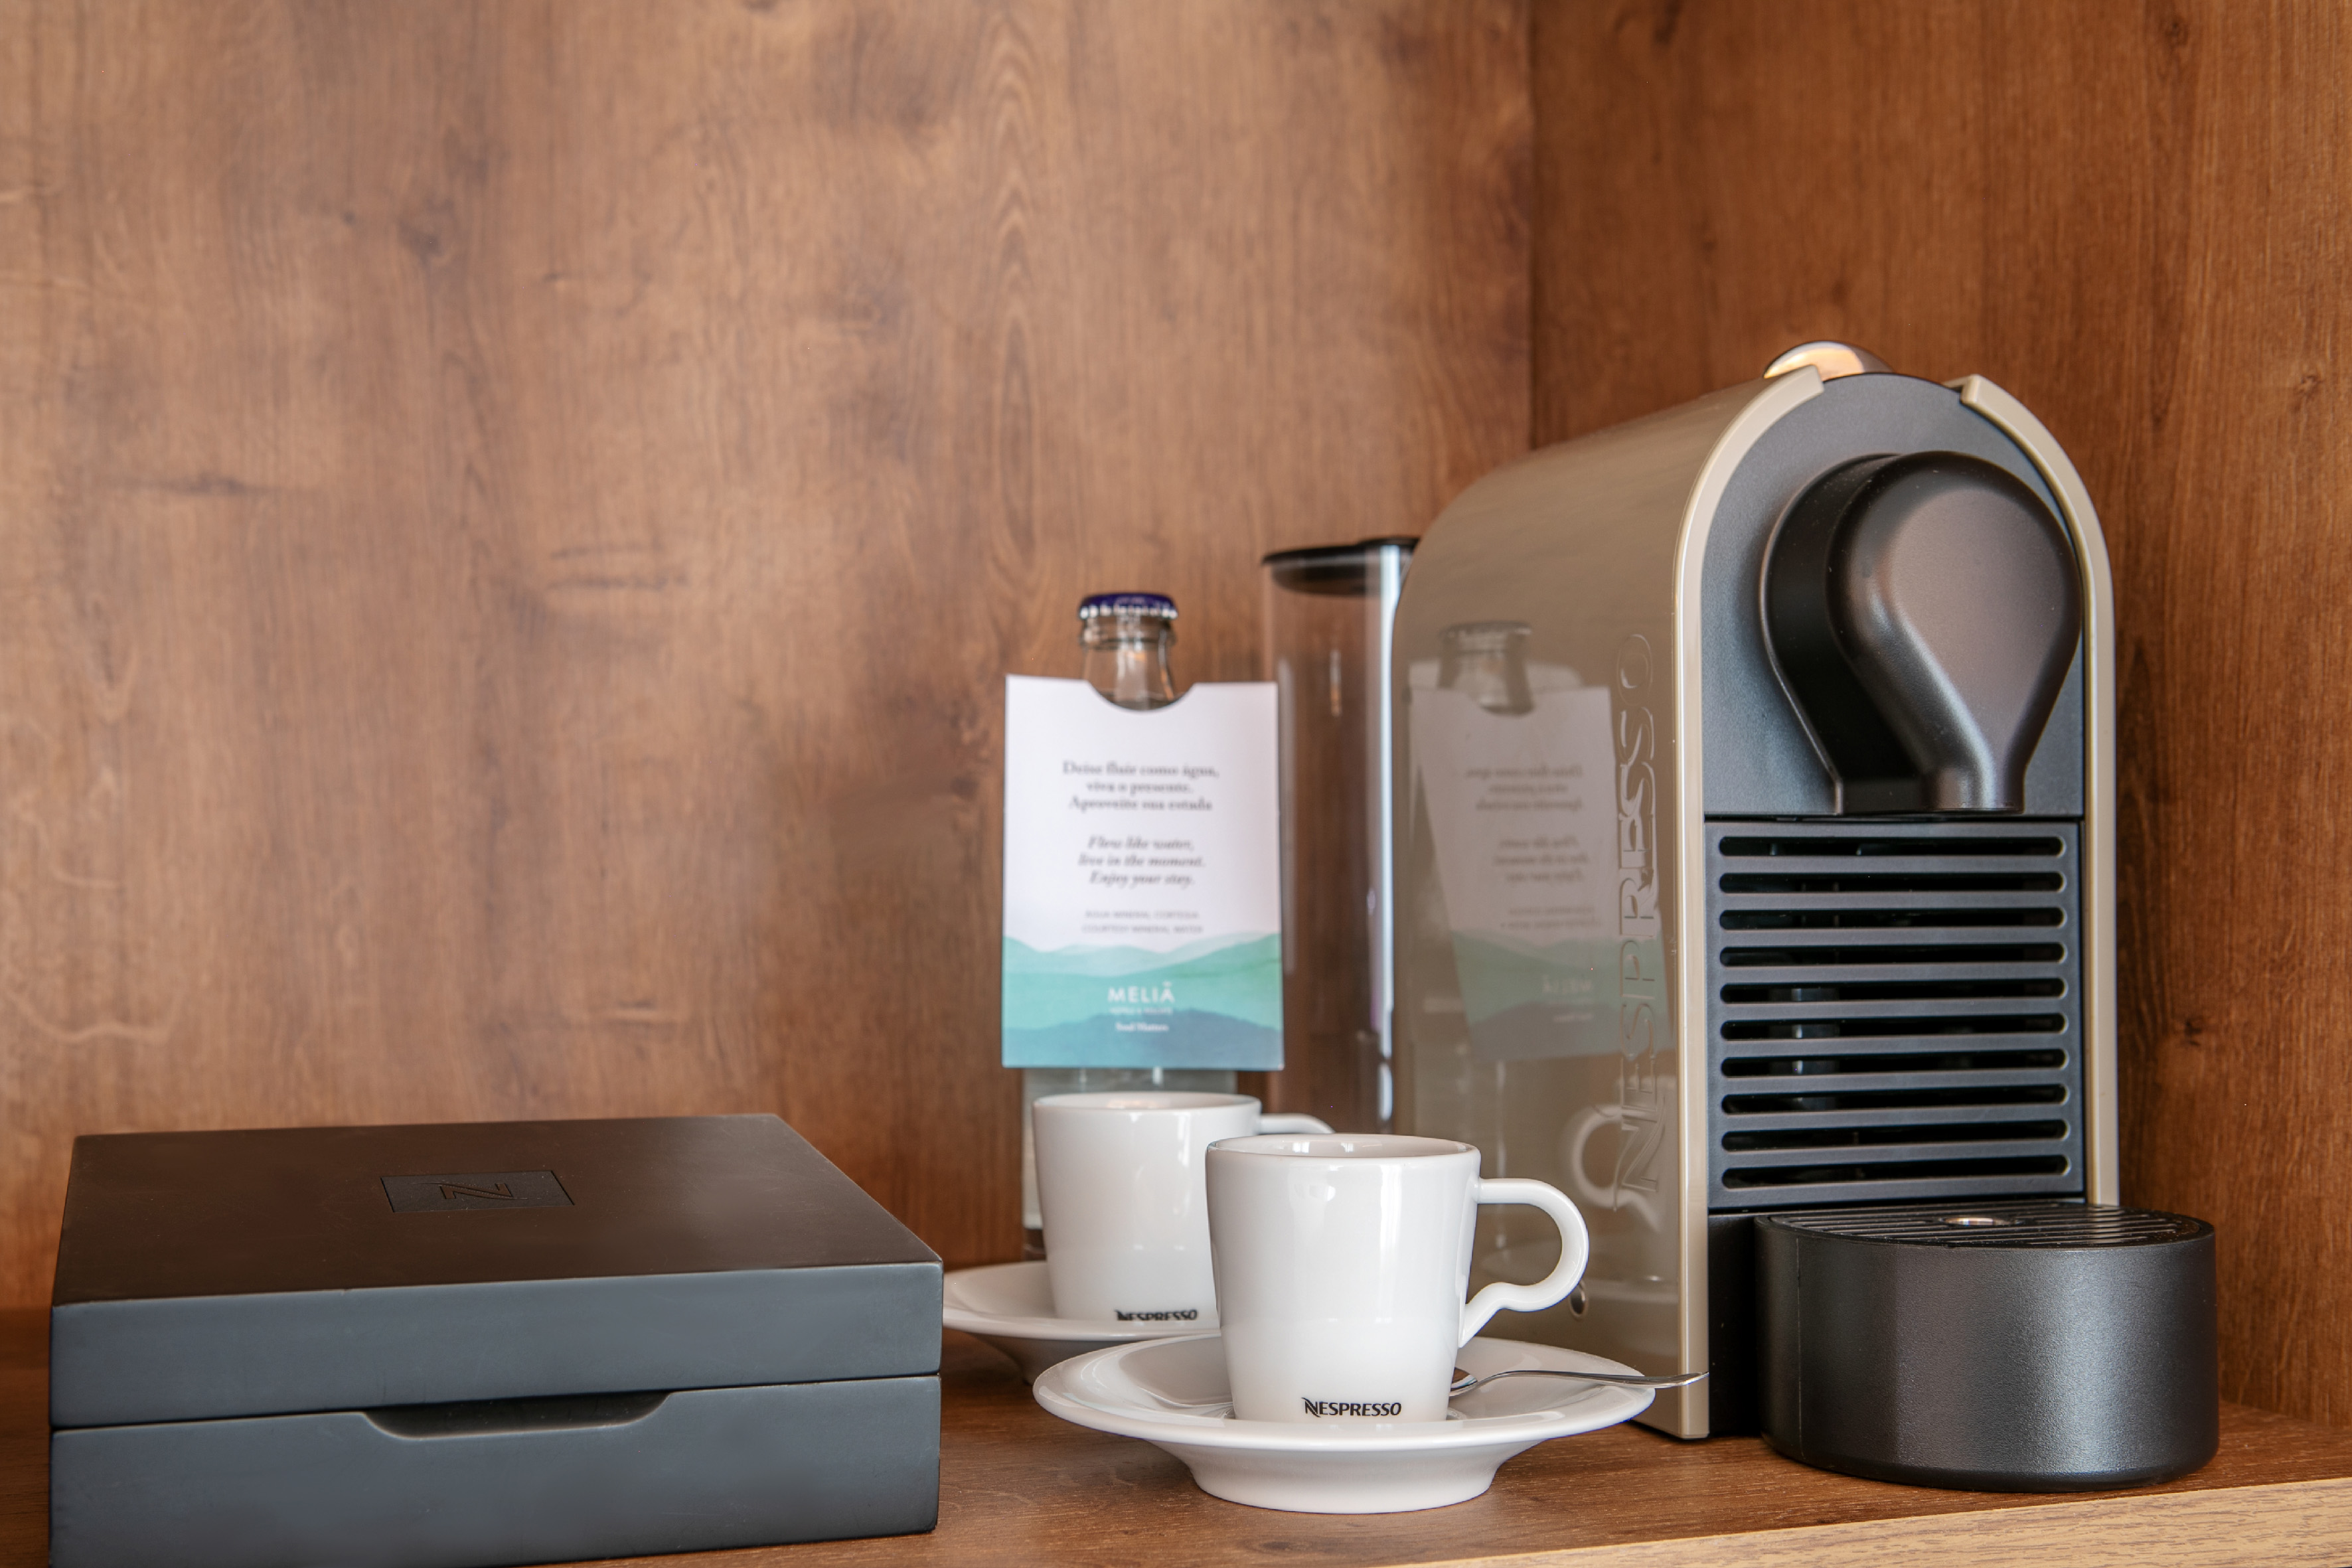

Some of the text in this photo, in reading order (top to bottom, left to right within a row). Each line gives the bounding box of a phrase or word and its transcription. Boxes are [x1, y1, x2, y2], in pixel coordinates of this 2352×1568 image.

[1614, 633, 1666, 1212] NESPRESSO
[1115, 1308, 1198, 1321] NESPRESSO
[1301, 1397, 1402, 1417] NESPRESSO
